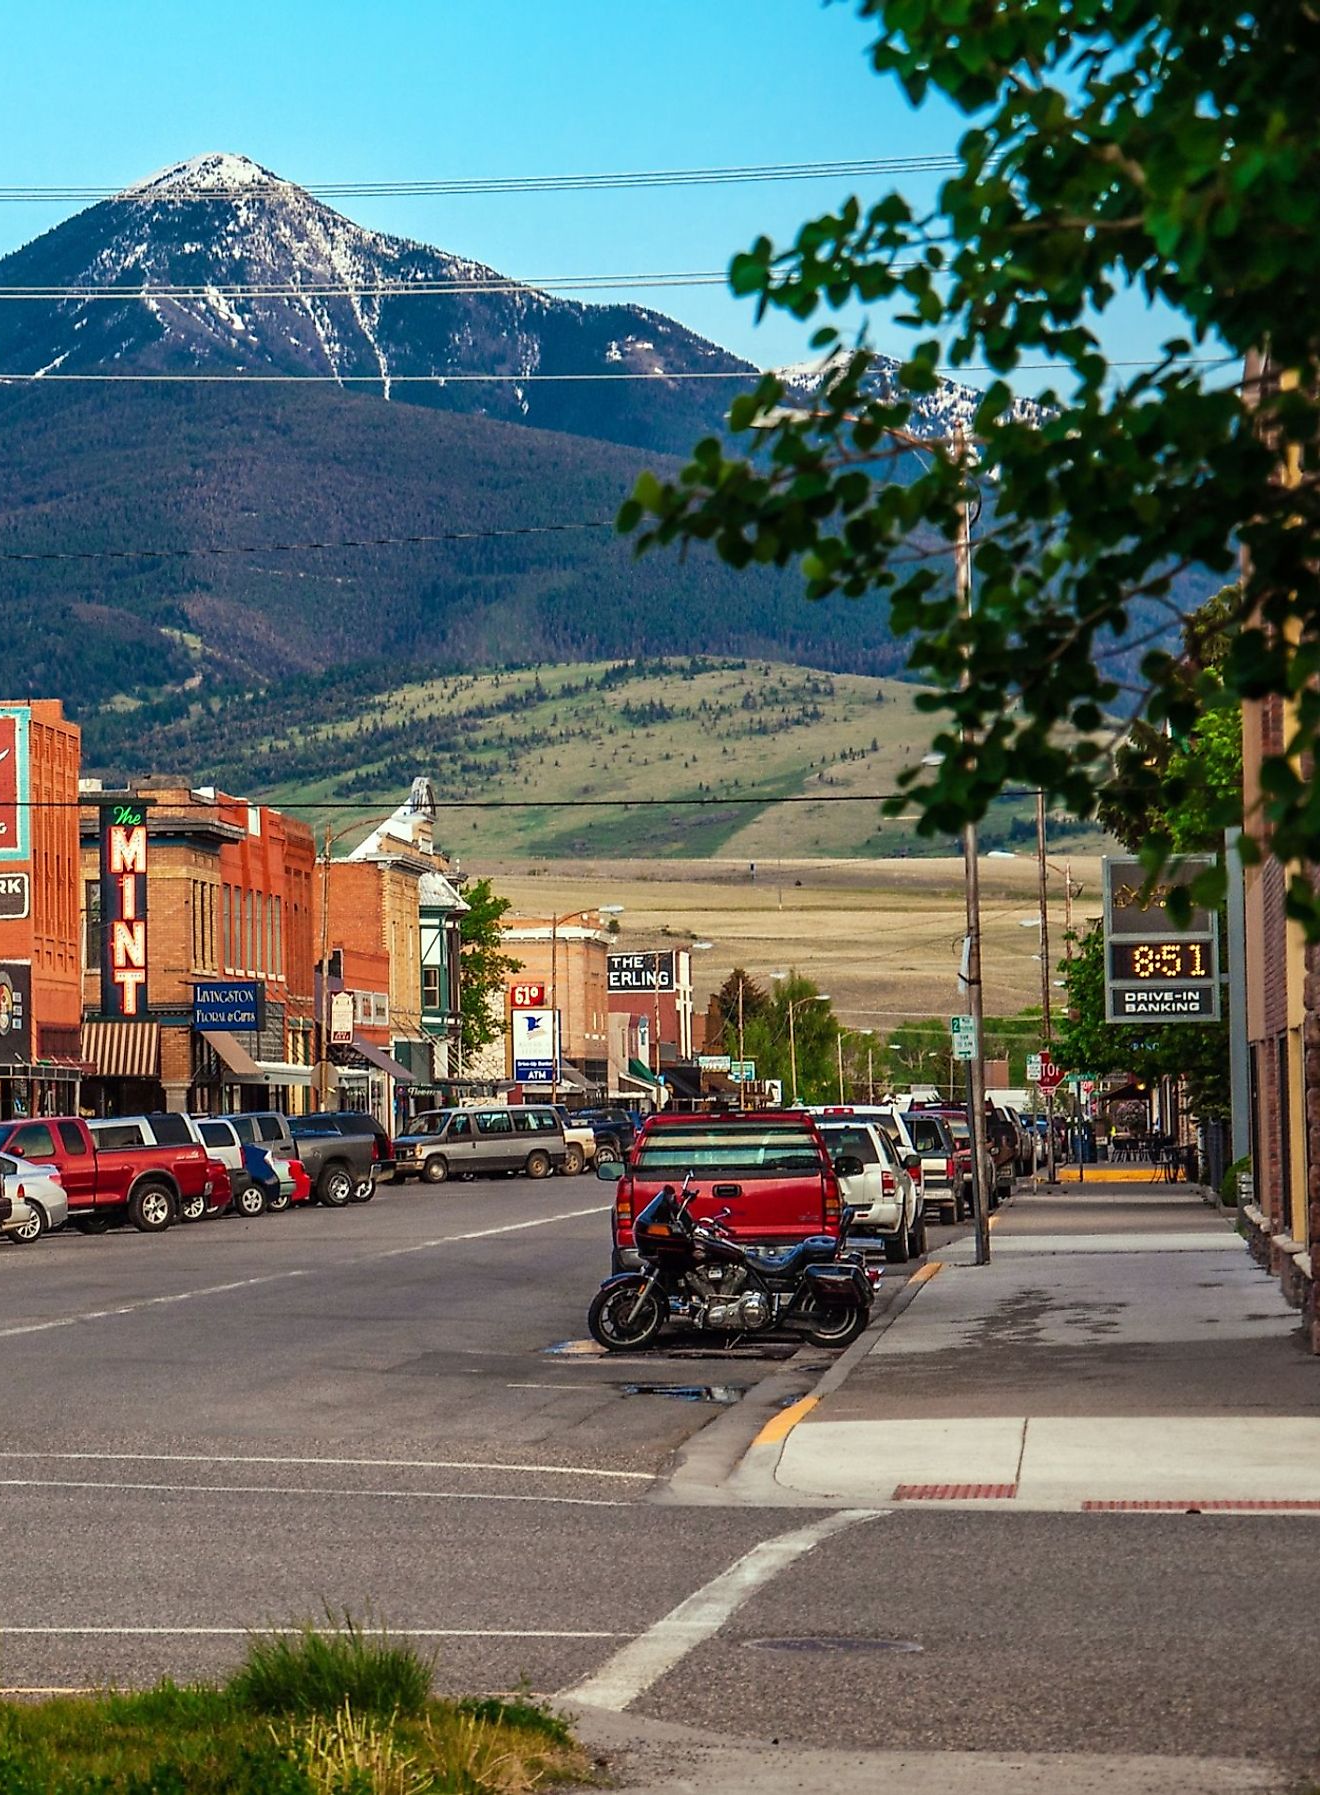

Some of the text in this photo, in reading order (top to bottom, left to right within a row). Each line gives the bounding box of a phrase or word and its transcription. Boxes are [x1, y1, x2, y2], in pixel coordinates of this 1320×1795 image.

[113, 806, 142, 825] The
[109, 826, 147, 1016] MINT
[611, 956, 644, 968] THE
[1133, 944, 1206, 978] 8:51
[607, 970, 669, 986] ERLING
[196, 986, 254, 1003] LIVINGSTON
[1124, 991, 1200, 1002] DRIVE-IN
[1124, 1002, 1200, 1012] BANKING
[528, 1070, 547, 1079] ATM
